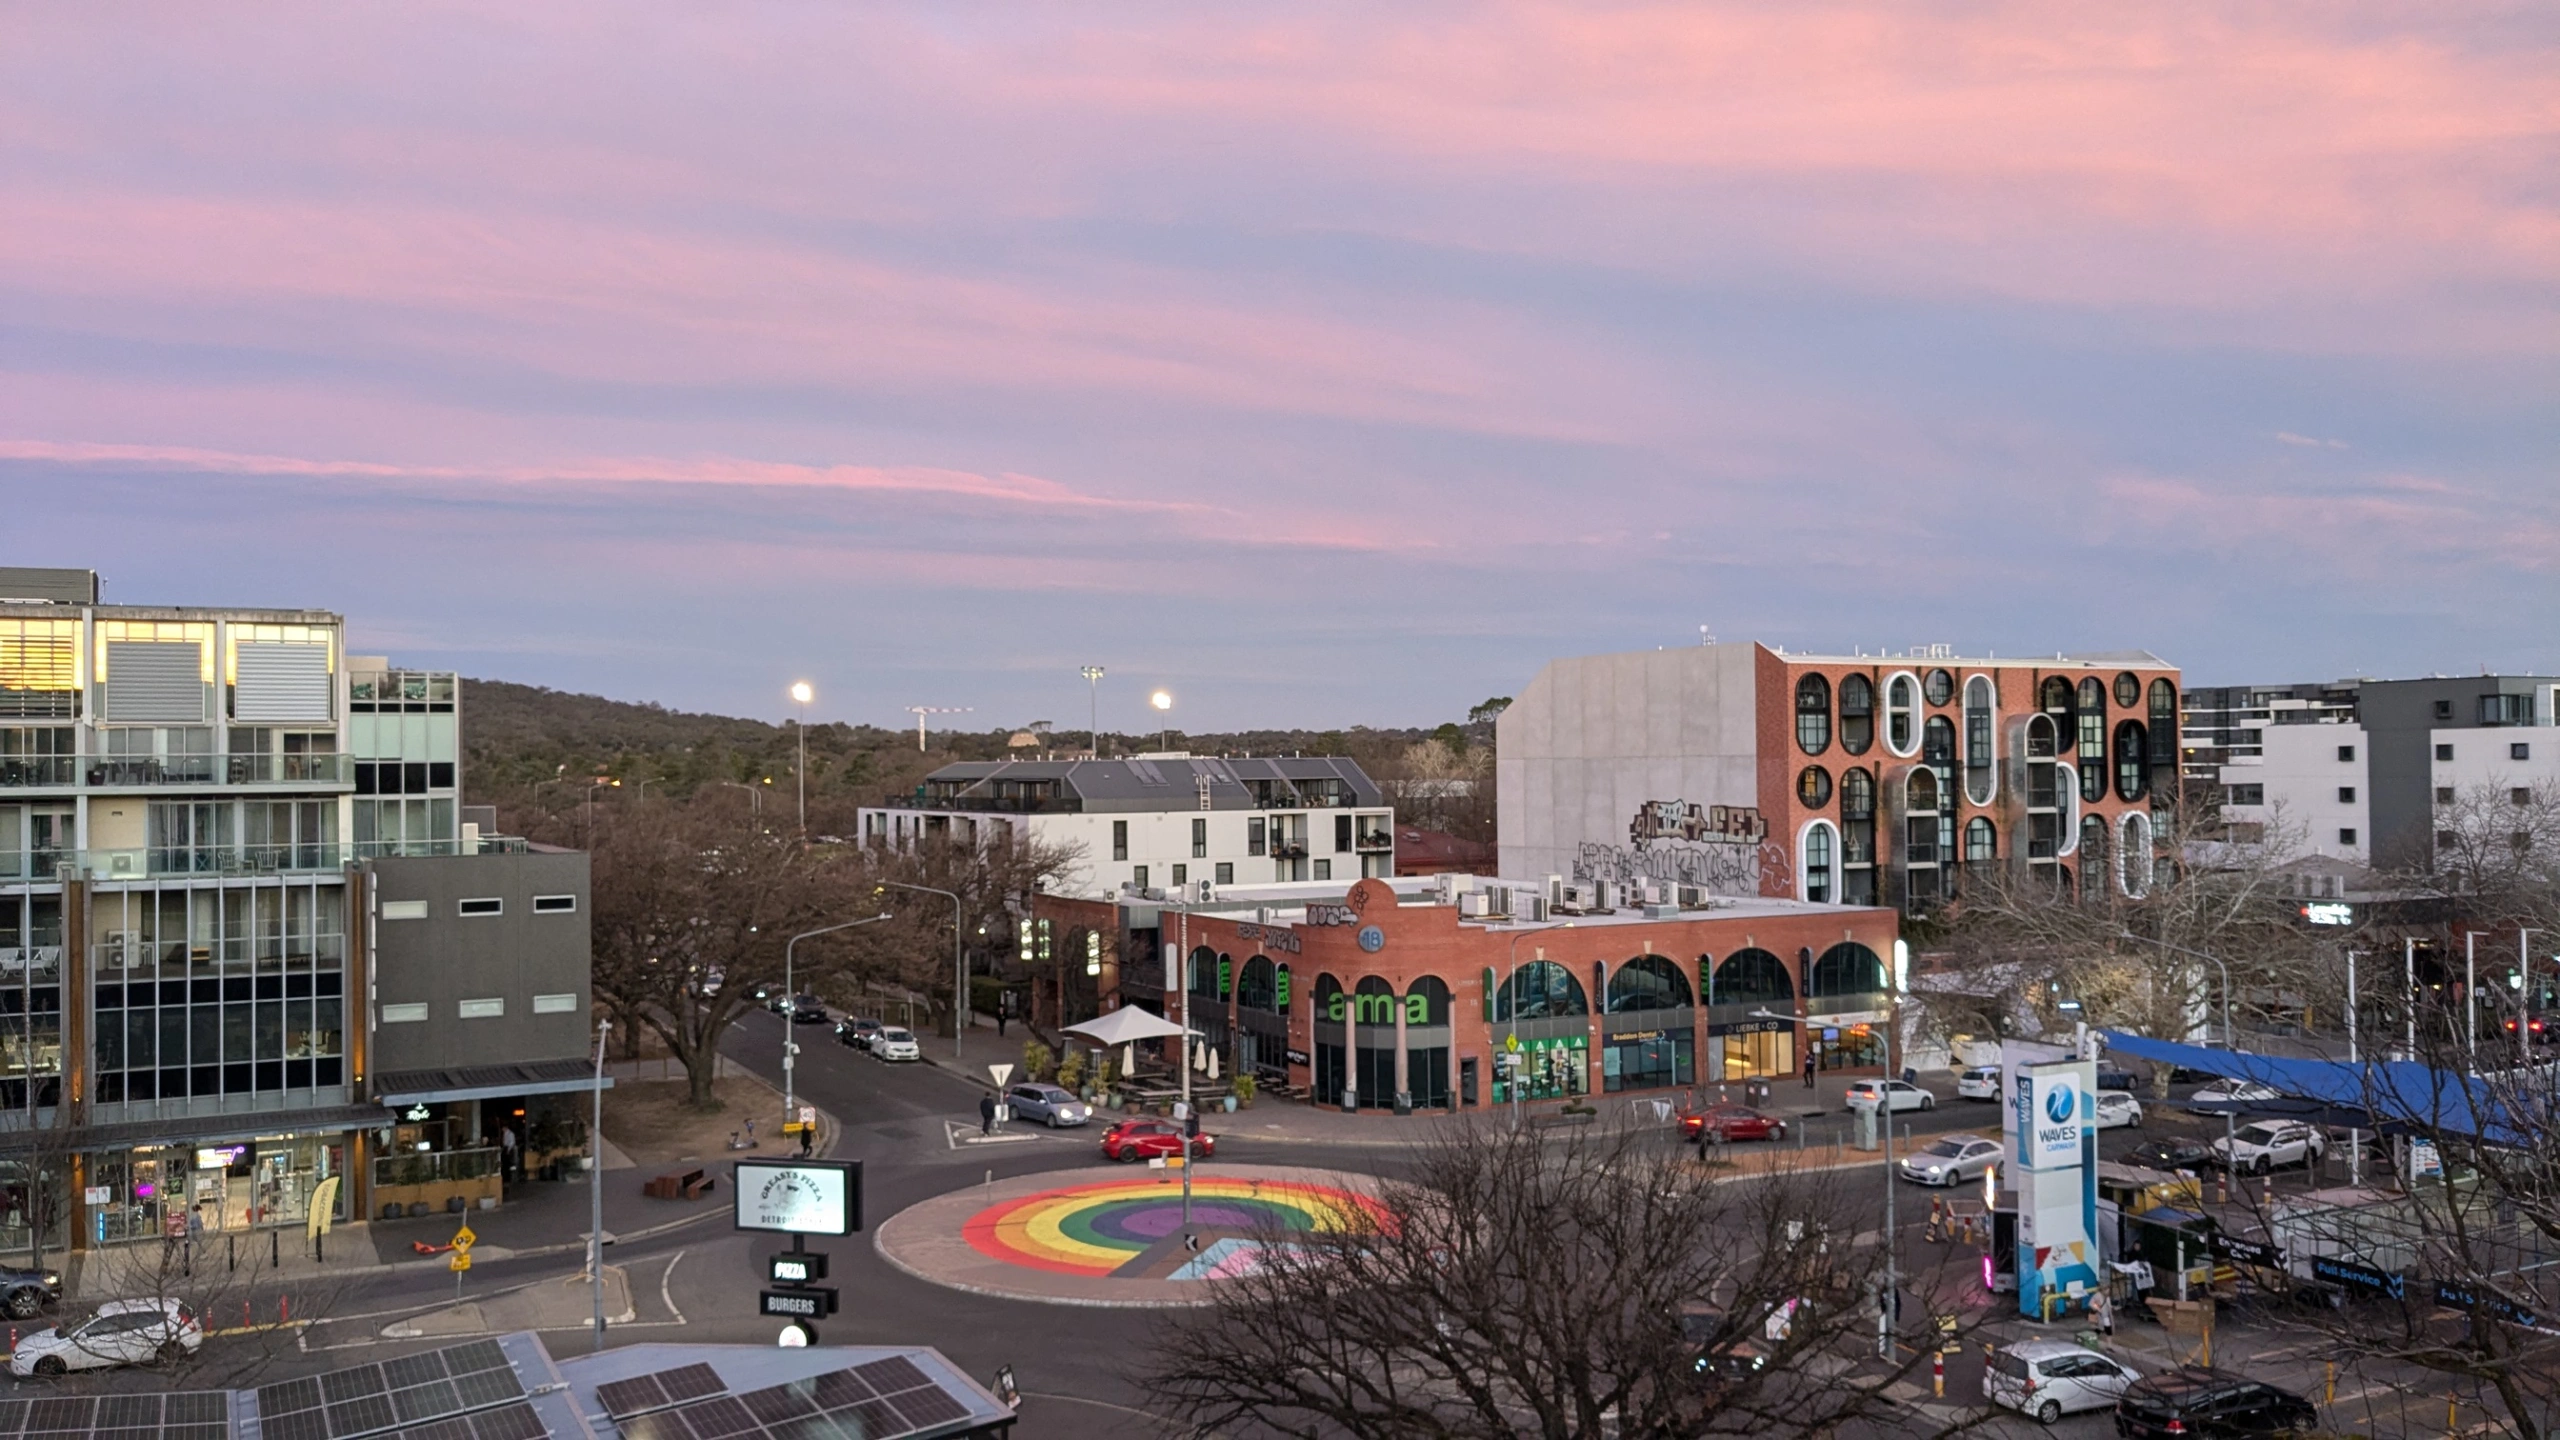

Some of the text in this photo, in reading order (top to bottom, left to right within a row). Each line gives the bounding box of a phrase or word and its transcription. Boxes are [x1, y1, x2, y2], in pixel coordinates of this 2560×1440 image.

[1766, 1021, 1779, 1031] CO
[1612, 1033, 1638, 1041] Braddon
[2020, 1080, 2031, 1123] WAVES
[2039, 1126, 2077, 1143] WAVES
[2046, 1142, 2077, 1152] CARWASH
[801, 1174, 823, 1202] PIZZA
[775, 1262, 807, 1279] PIZZA
[2317, 1262, 2381, 1286] Full Service
[767, 1296, 815, 1315] BURGERS
